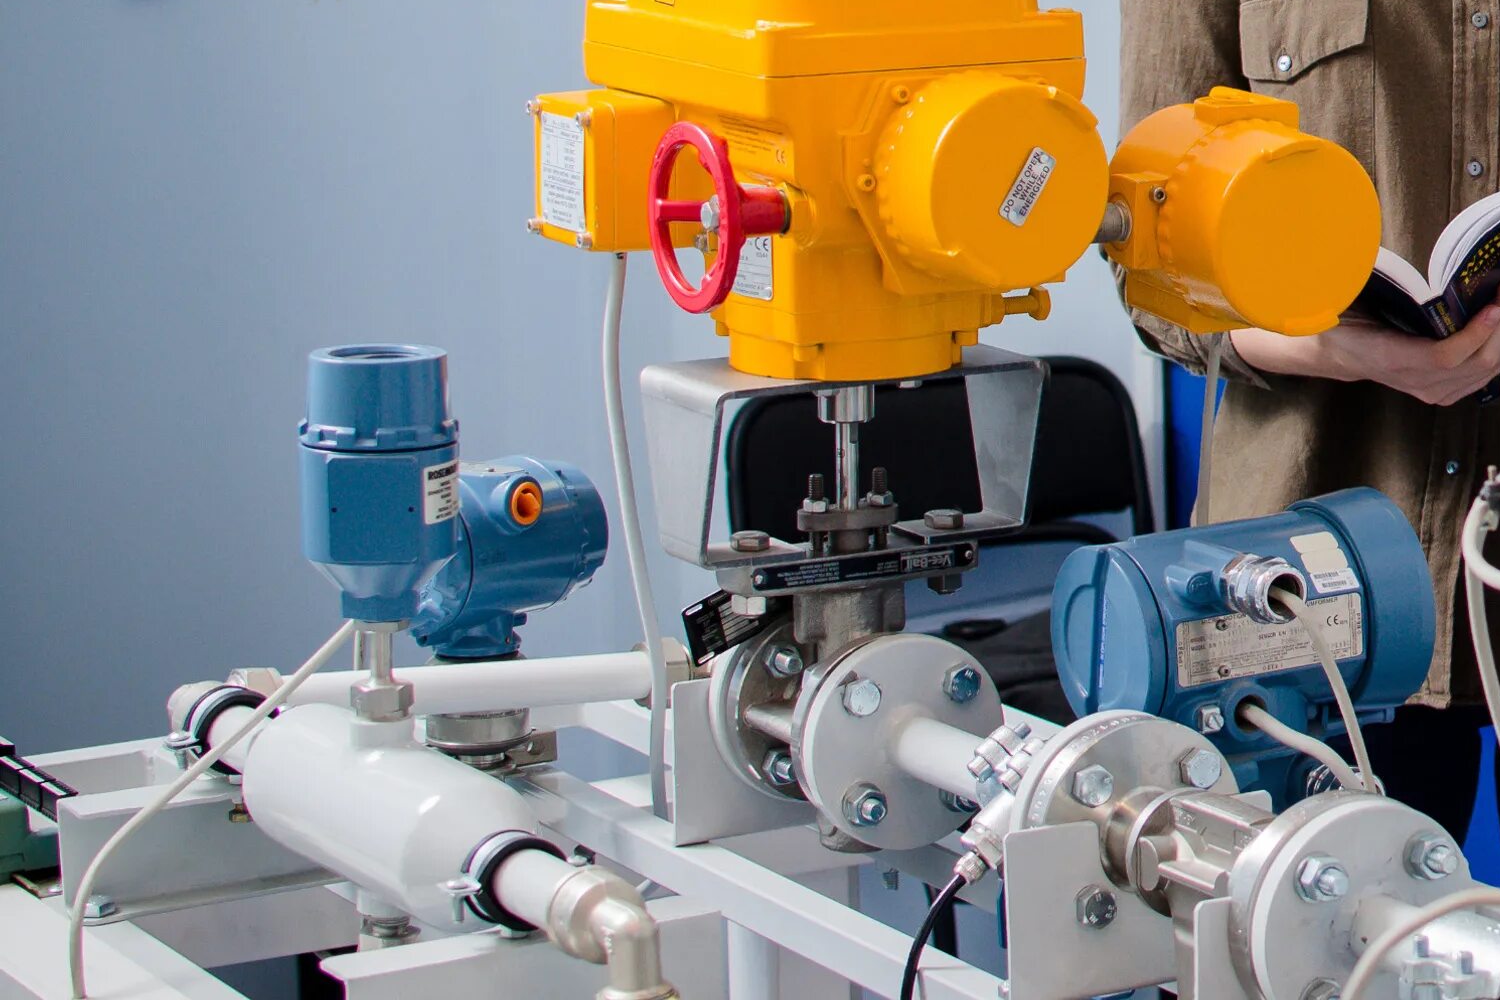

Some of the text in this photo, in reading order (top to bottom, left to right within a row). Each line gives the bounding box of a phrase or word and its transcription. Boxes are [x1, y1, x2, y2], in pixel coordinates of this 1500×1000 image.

[1003, 151, 1042, 214] DO NOT OPEN
[1019, 172, 1039, 201] WHILE
[1019, 165, 1051, 217] ENERGIZED
